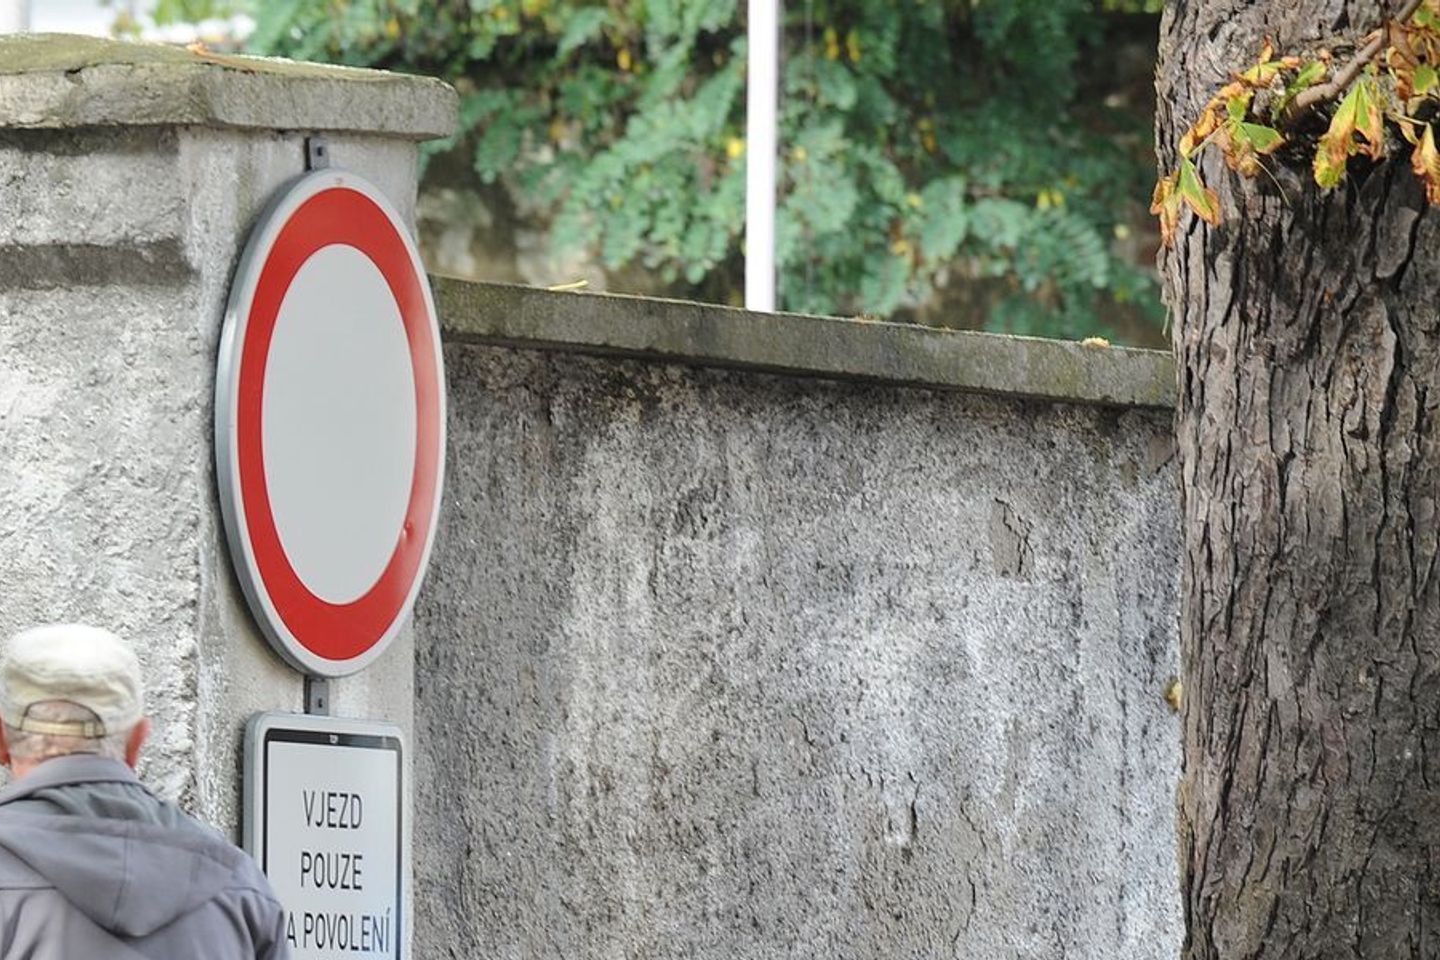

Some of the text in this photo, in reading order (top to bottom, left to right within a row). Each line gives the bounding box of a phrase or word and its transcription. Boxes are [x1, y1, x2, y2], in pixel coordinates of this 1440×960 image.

[303, 790, 362, 829] VJEZD
[300, 852, 363, 890] POUZE
[286, 907, 391, 952] A POVOLENÍ
